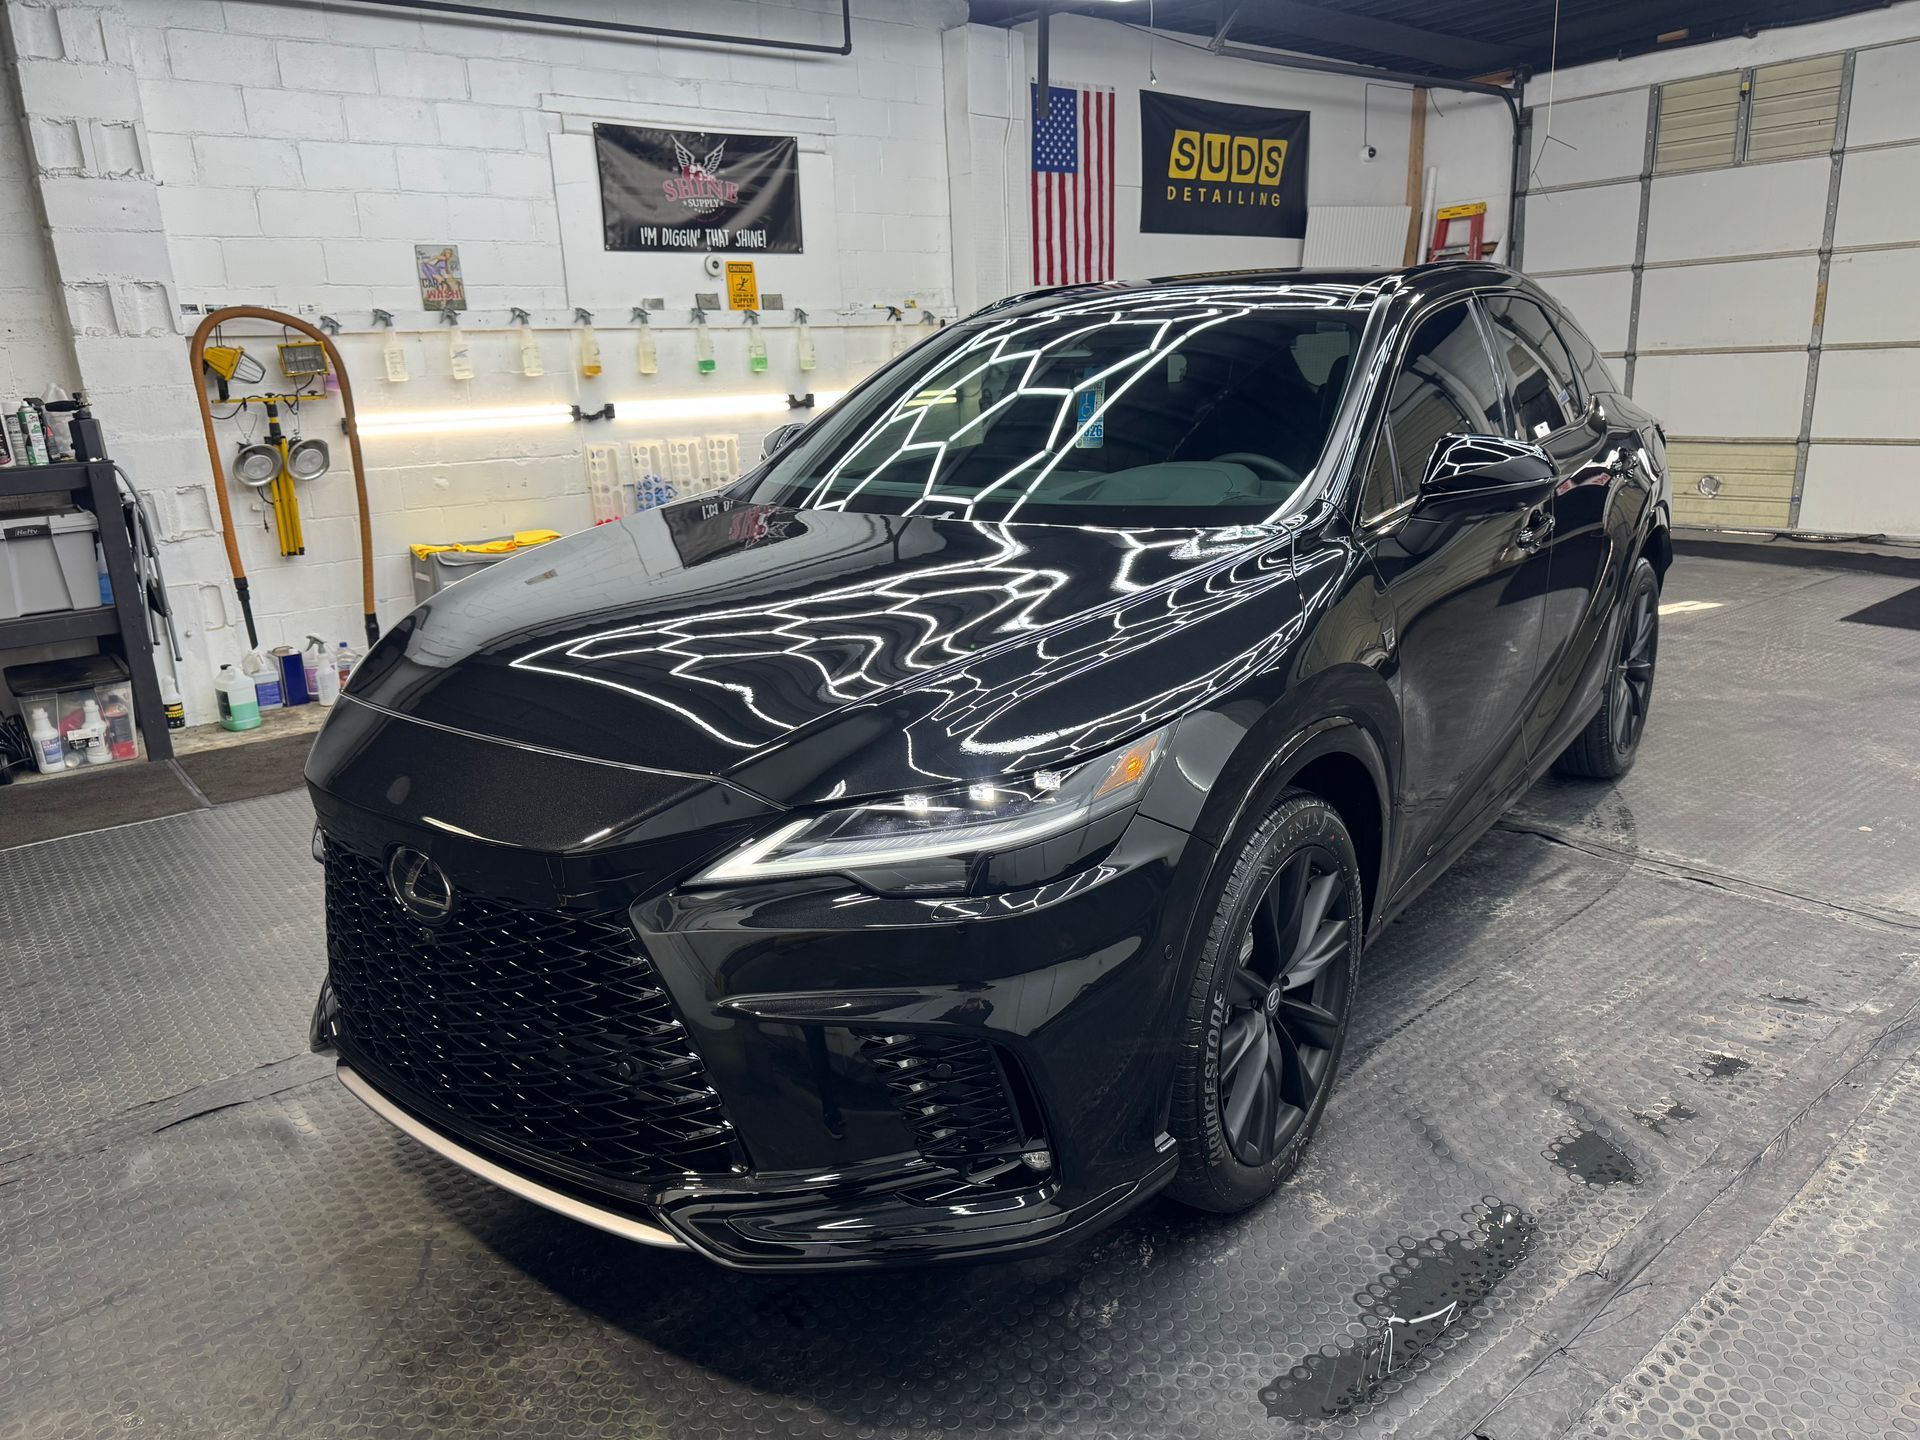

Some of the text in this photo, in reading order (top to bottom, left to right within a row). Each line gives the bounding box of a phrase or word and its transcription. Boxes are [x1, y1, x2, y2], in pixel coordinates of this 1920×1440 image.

[1174, 136, 1283, 180] SUDS
[662, 176, 740, 204] SHINE
[1166, 185, 1282, 208] DETAILING
[687, 198, 720, 208] SUPPLY
[640, 226, 767, 249] I'M DIGGIN' THAT SHINE!
[16, 528, 39, 537] Hefty
[1204, 990, 1226, 1168] BRIDGESTONE
